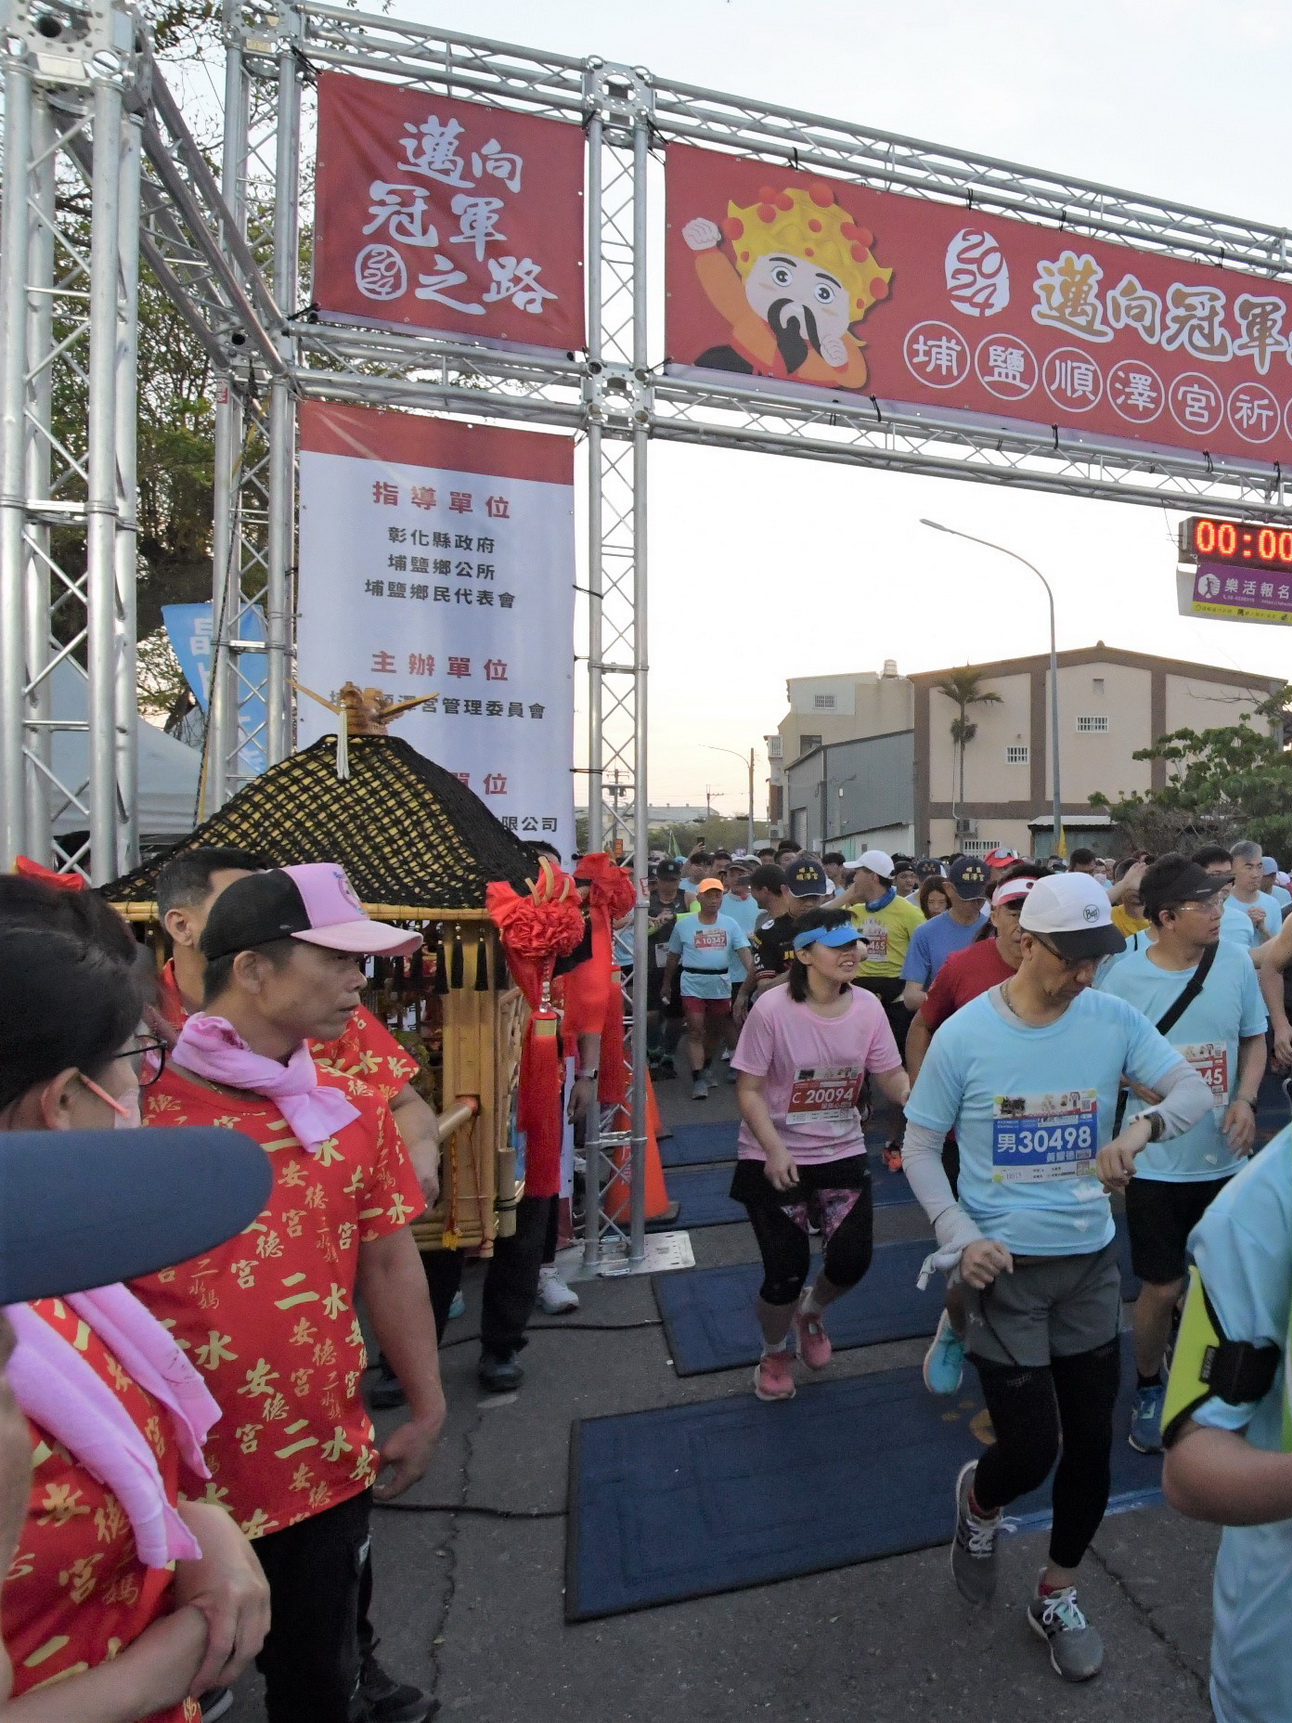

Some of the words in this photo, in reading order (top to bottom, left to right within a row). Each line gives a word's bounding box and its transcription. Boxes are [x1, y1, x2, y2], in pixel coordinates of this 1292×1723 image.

[397, 115, 523, 193] 邁向
[362, 180, 508, 262] 冠軍
[415, 254, 559, 315] 之路
[372, 480, 511, 519] 指導單位
[387, 526, 496, 554] 彰化縣政府
[387, 553, 496, 581] 埔鹽鄉公所
[364, 579, 516, 609] 埔鹽鄉民代表會
[370, 650, 510, 682] 主辦單位
[804, 1087, 854, 1104] 20094
